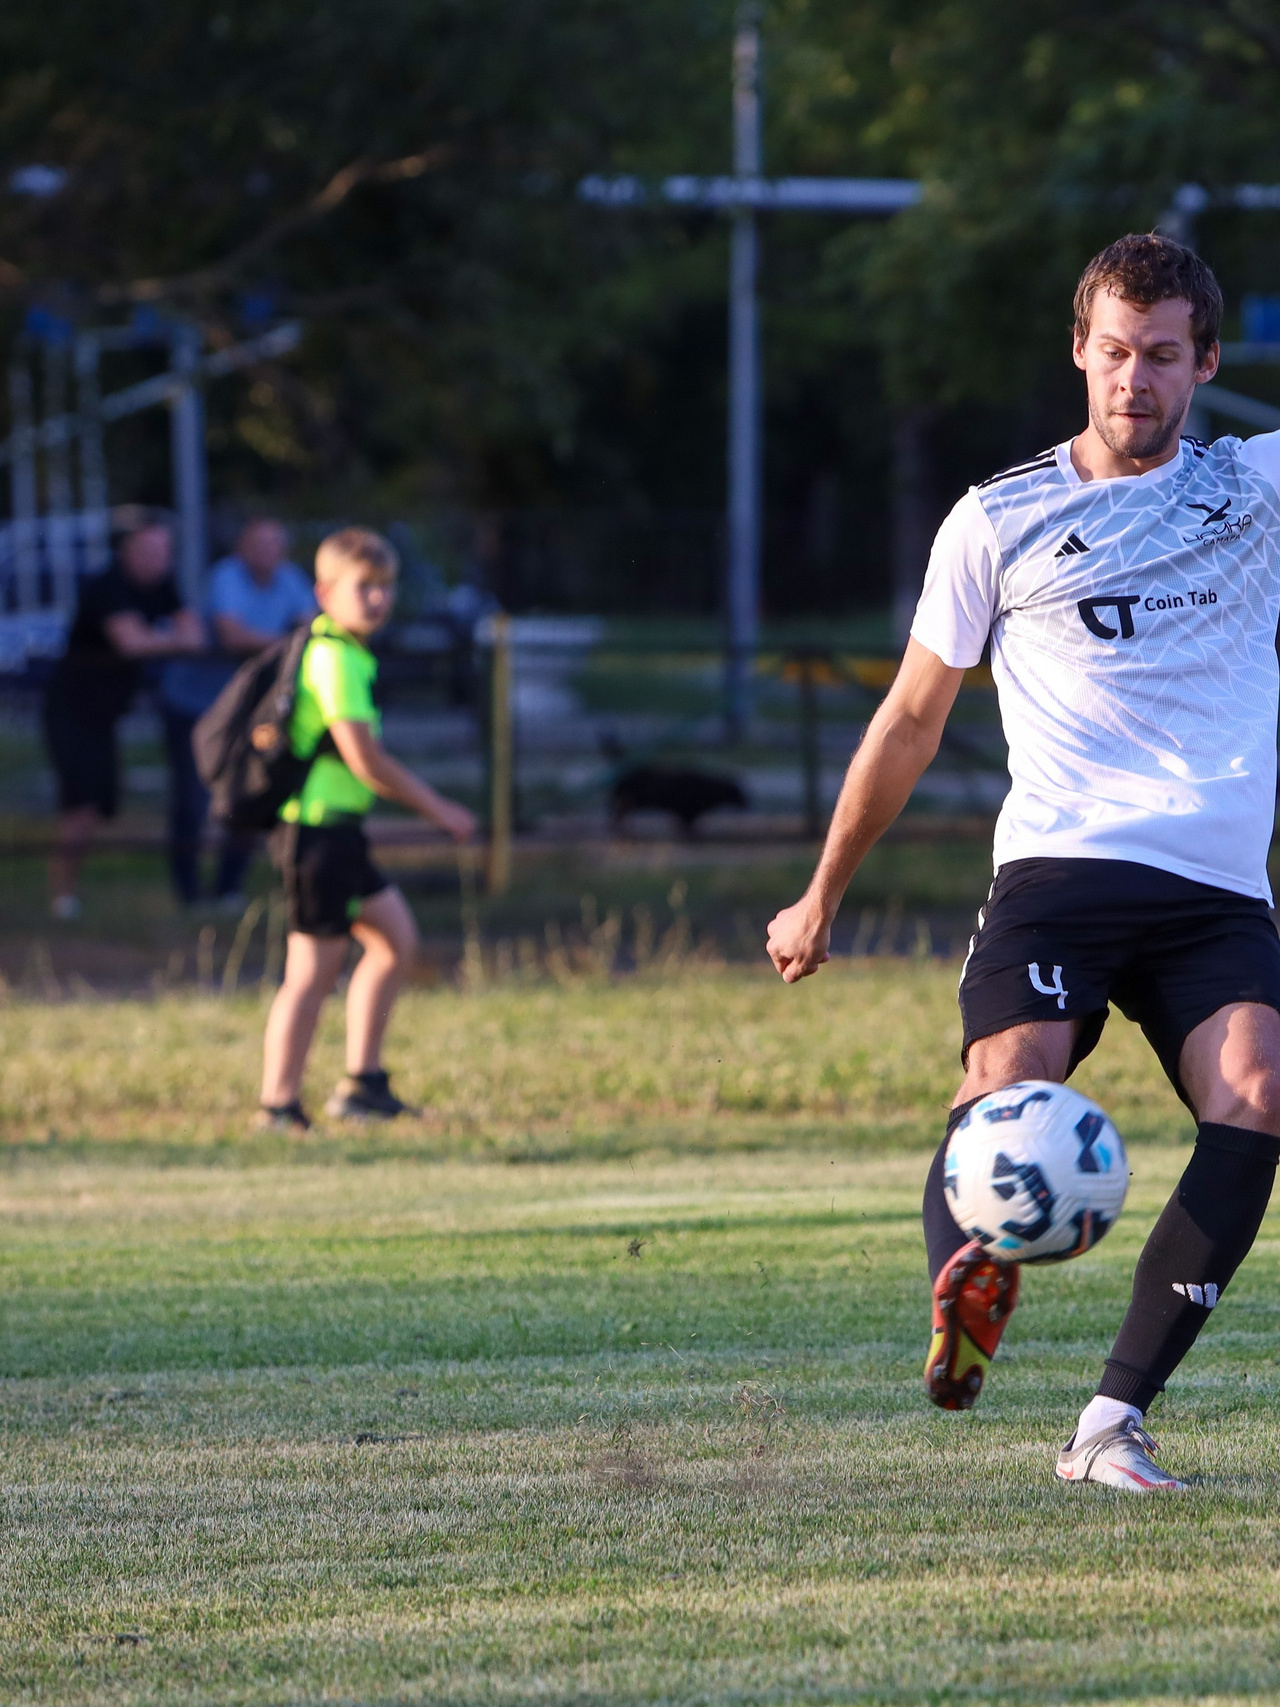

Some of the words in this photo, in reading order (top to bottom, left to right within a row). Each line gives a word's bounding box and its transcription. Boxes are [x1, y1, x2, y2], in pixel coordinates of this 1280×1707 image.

[1203, 534, 1242, 547] САМАРА
[1144, 593, 1184, 612] Coin
[1187, 588, 1218, 606] Tab
[1027, 962, 1069, 1010] 4
